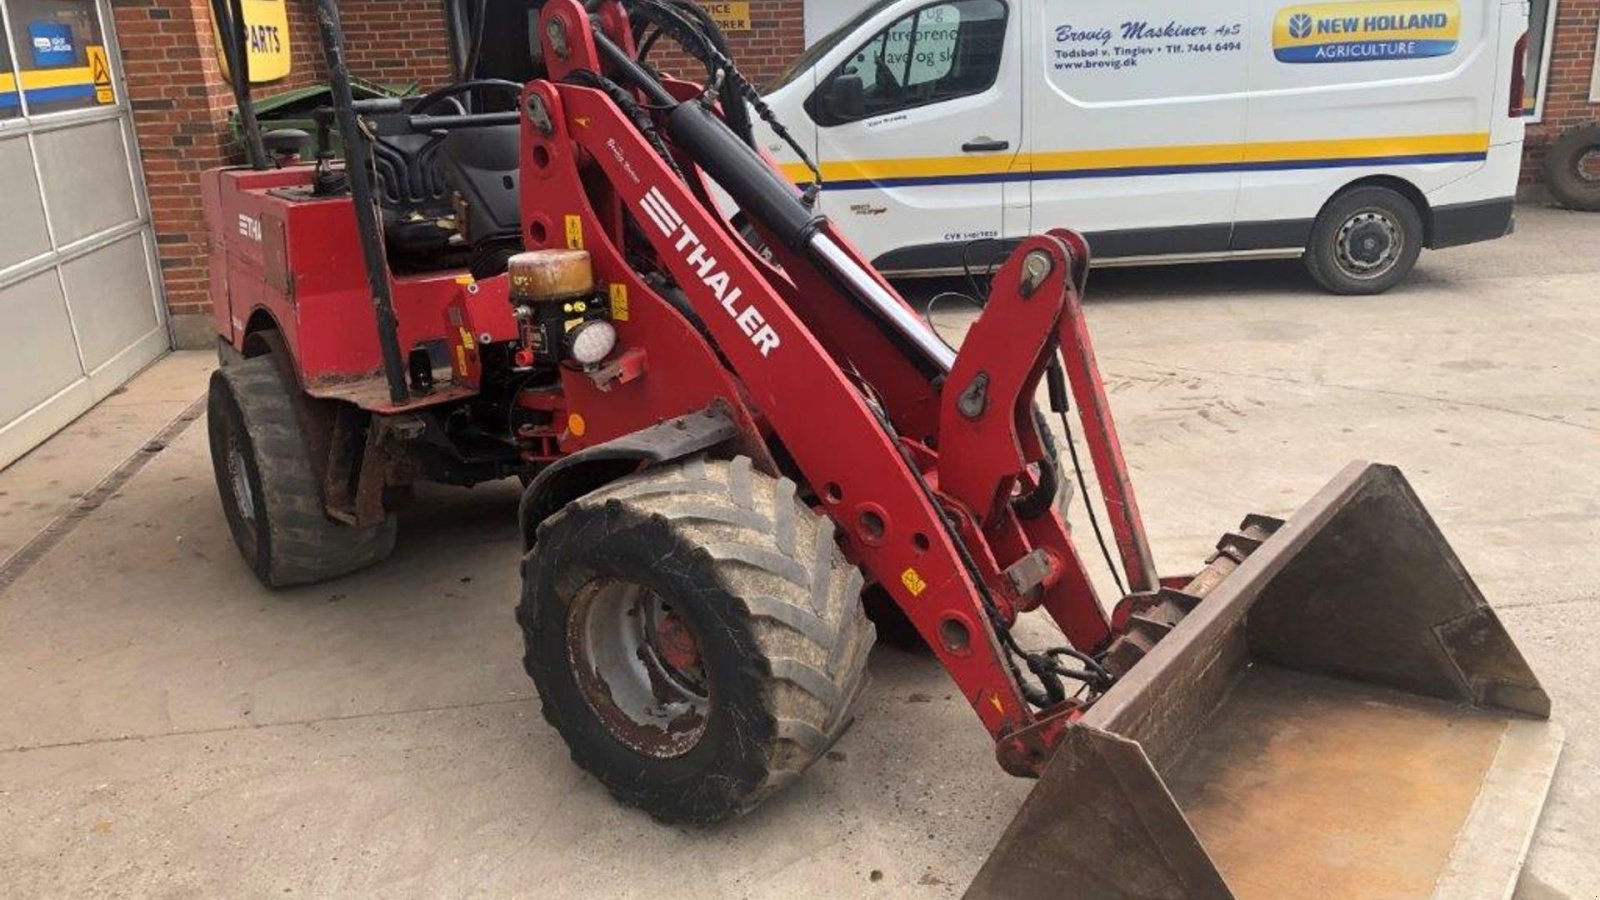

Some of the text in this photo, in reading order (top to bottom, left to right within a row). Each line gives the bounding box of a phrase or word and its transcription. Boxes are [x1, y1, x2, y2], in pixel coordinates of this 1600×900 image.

[1317, 13, 1447, 34] NEW HOLLAND
[1055, 24, 1111, 46] Brovig
[1120, 21, 1207, 39] Maskiner
[1315, 41, 1416, 59] AGRICULTURE
[916, 52, 935, 67] og
[1054, 58, 1137, 70] www.brovig.dk
